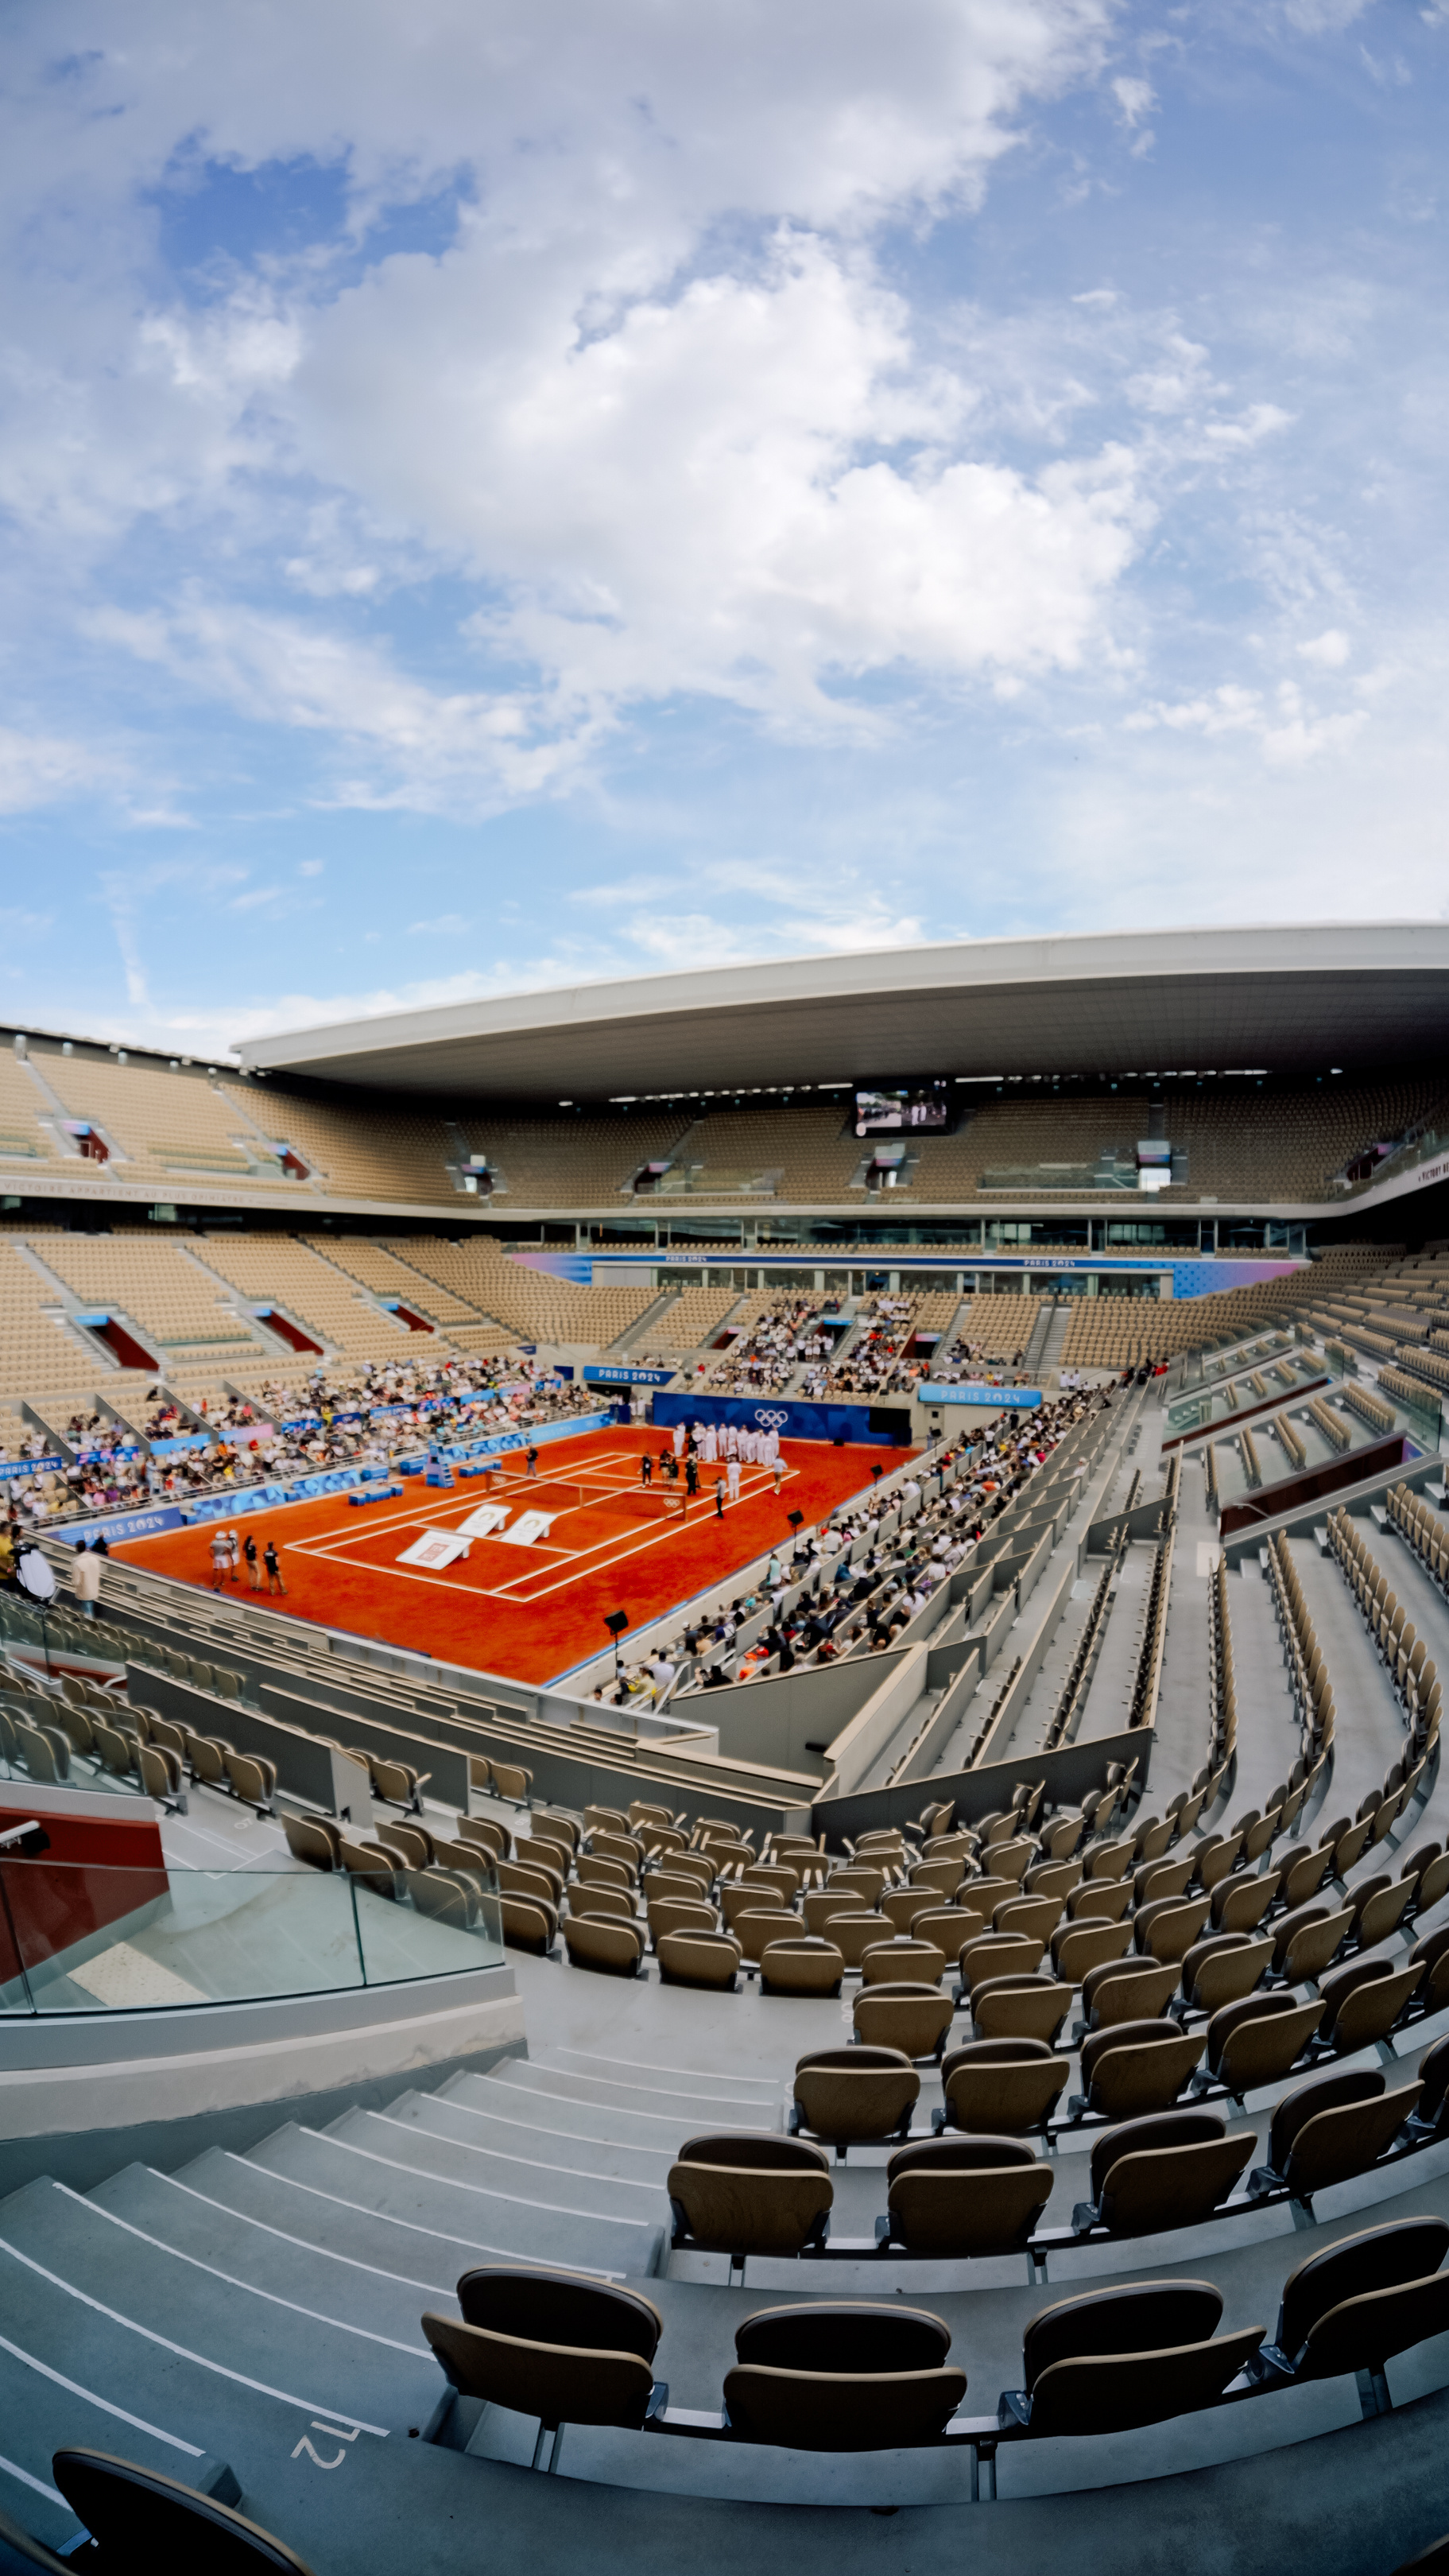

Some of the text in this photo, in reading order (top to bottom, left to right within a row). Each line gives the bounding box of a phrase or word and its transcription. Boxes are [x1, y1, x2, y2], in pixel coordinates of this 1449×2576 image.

[4, 1183, 63, 1193] VICTOIRE
[69, 1187, 138, 1197] APPARTIENT
[599, 1368, 661, 1382] PARIS 2024
[941, 1391, 1021, 1403] PARIS 2024
[31, 1461, 58, 1472] 2024
[83, 1517, 164, 1542] PARIS 2024
[290, 2421, 361, 2469] 12
